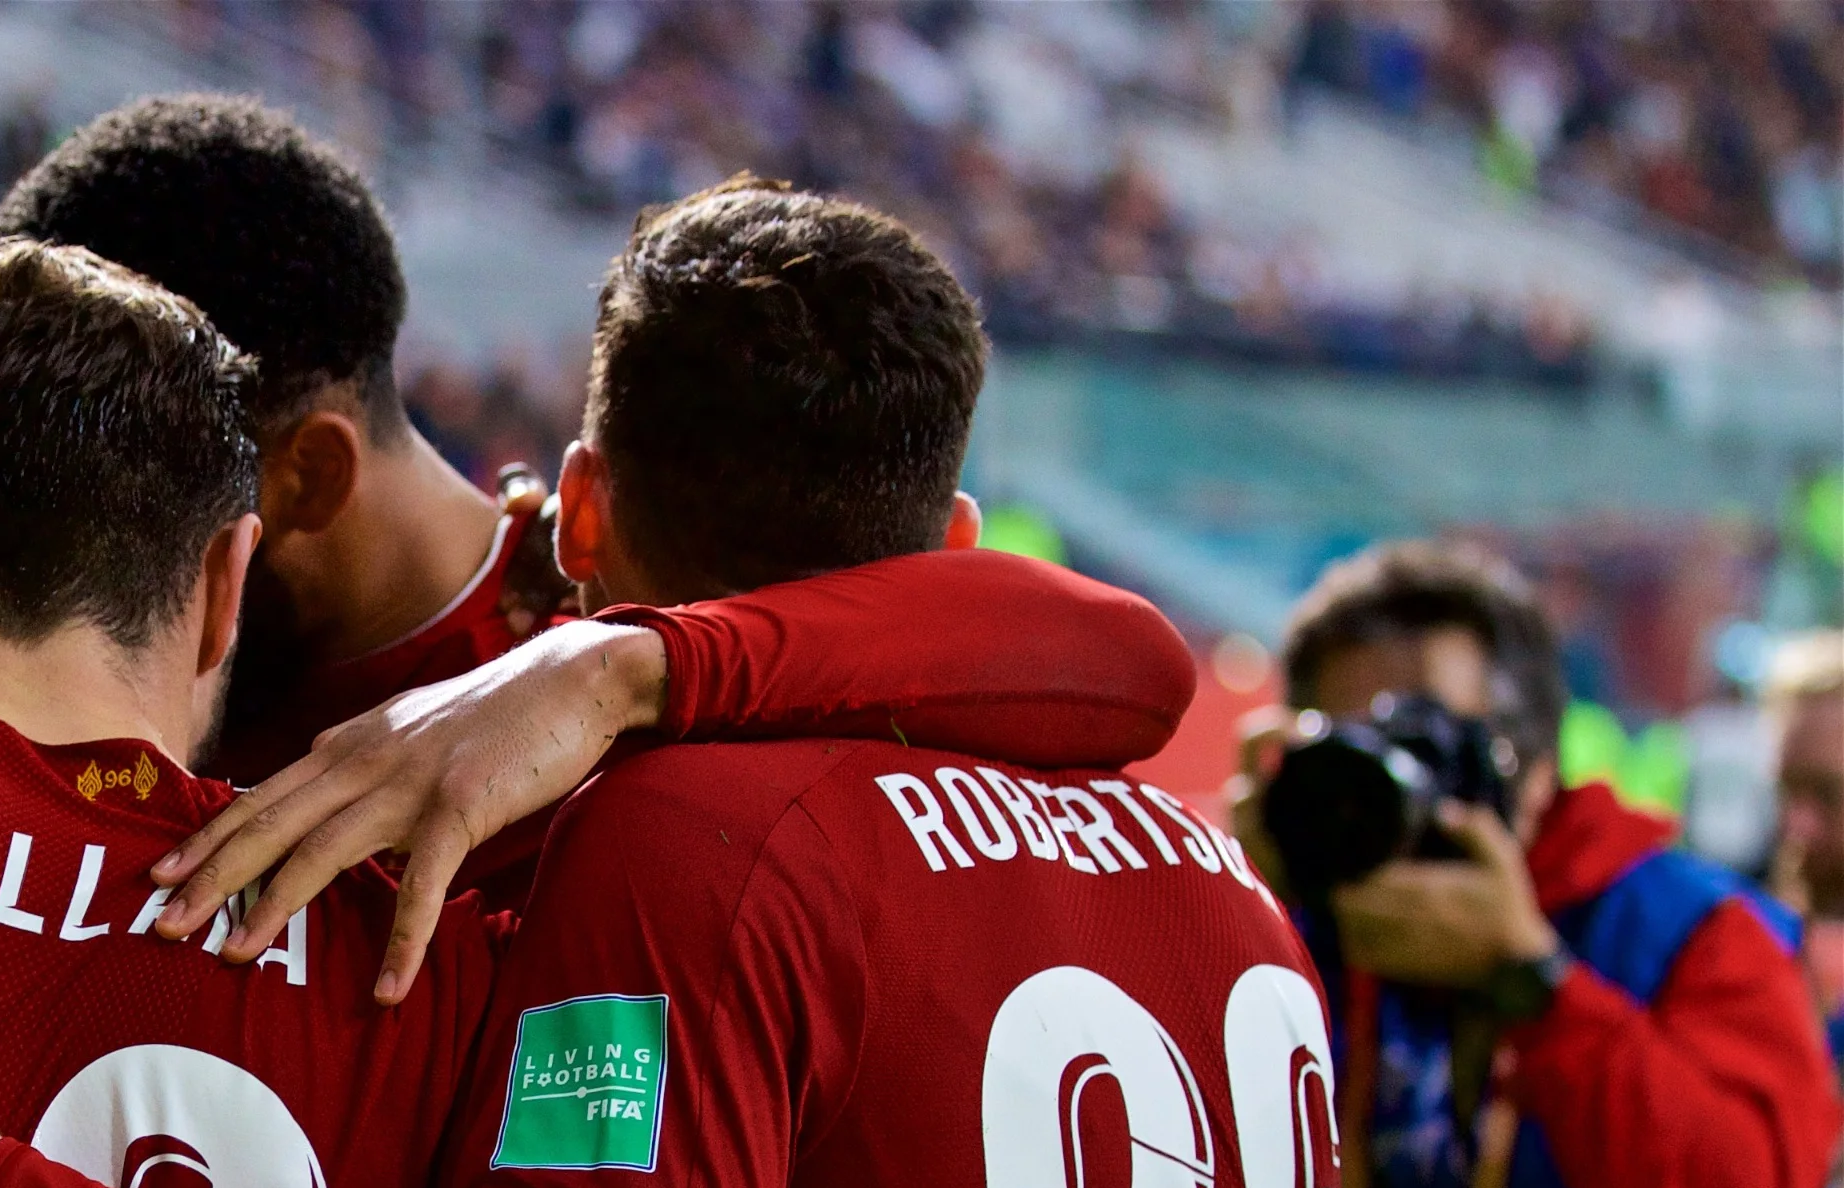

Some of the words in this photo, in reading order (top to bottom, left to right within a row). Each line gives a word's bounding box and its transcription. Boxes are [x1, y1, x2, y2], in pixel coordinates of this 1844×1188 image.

[104, 769, 132, 789] 96
[874, 766, 1284, 921] ROBERTSO
[525, 1043, 651, 1070] LIVING
[522, 1062, 648, 1089] FOOTBALL
[586, 1098, 644, 1121] FIFA
